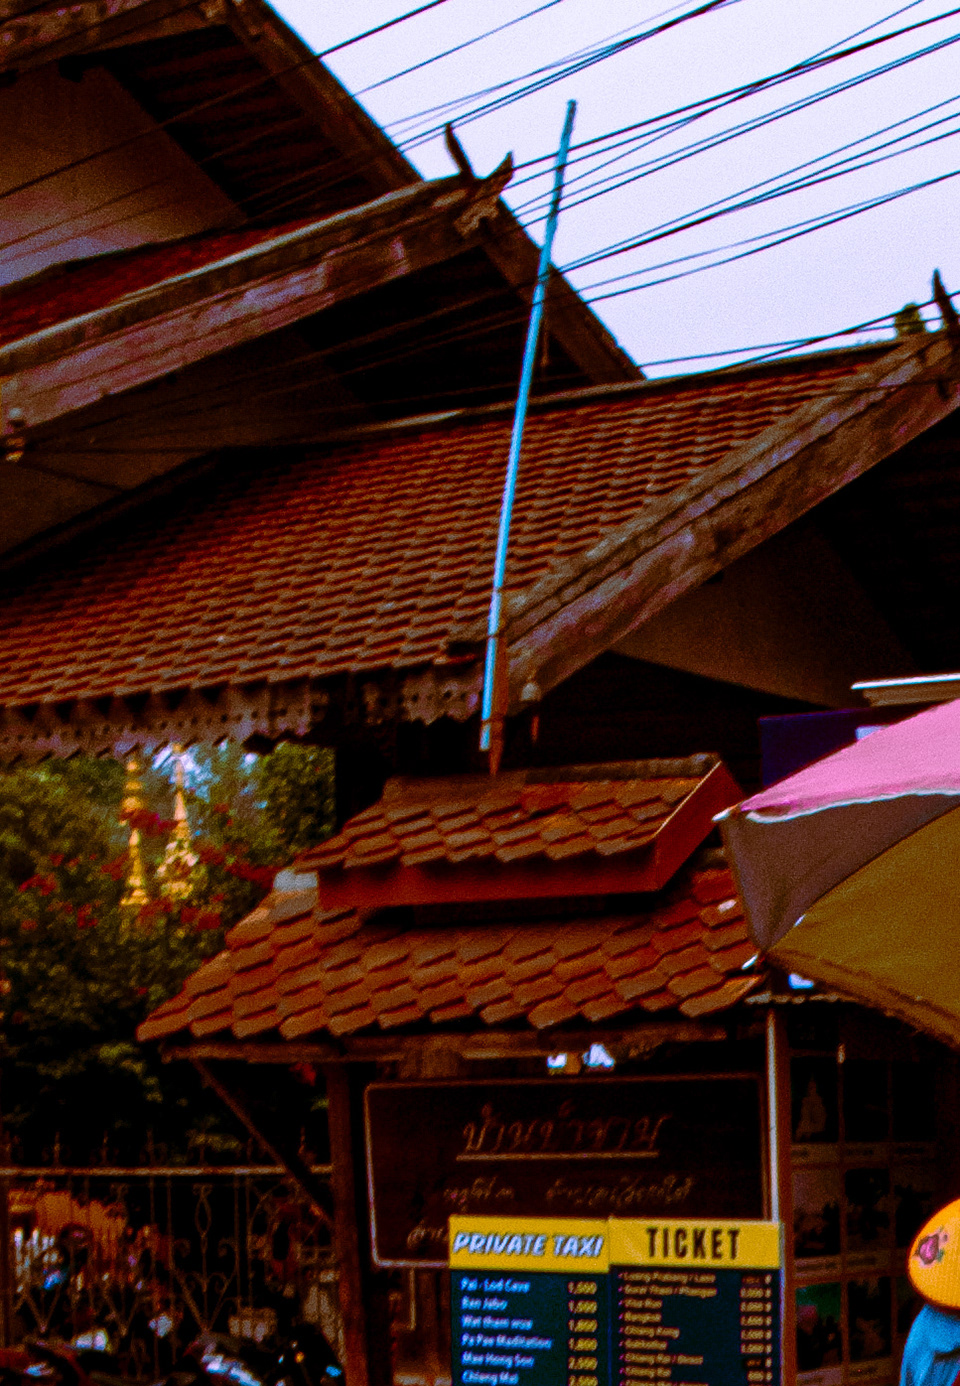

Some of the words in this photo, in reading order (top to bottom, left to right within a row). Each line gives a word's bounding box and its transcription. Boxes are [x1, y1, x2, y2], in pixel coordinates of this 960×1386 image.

[453, 1231, 547, 1256] PRIVATE
[553, 1235, 604, 1257] TAXI
[647, 1228, 741, 1260] TICKET
